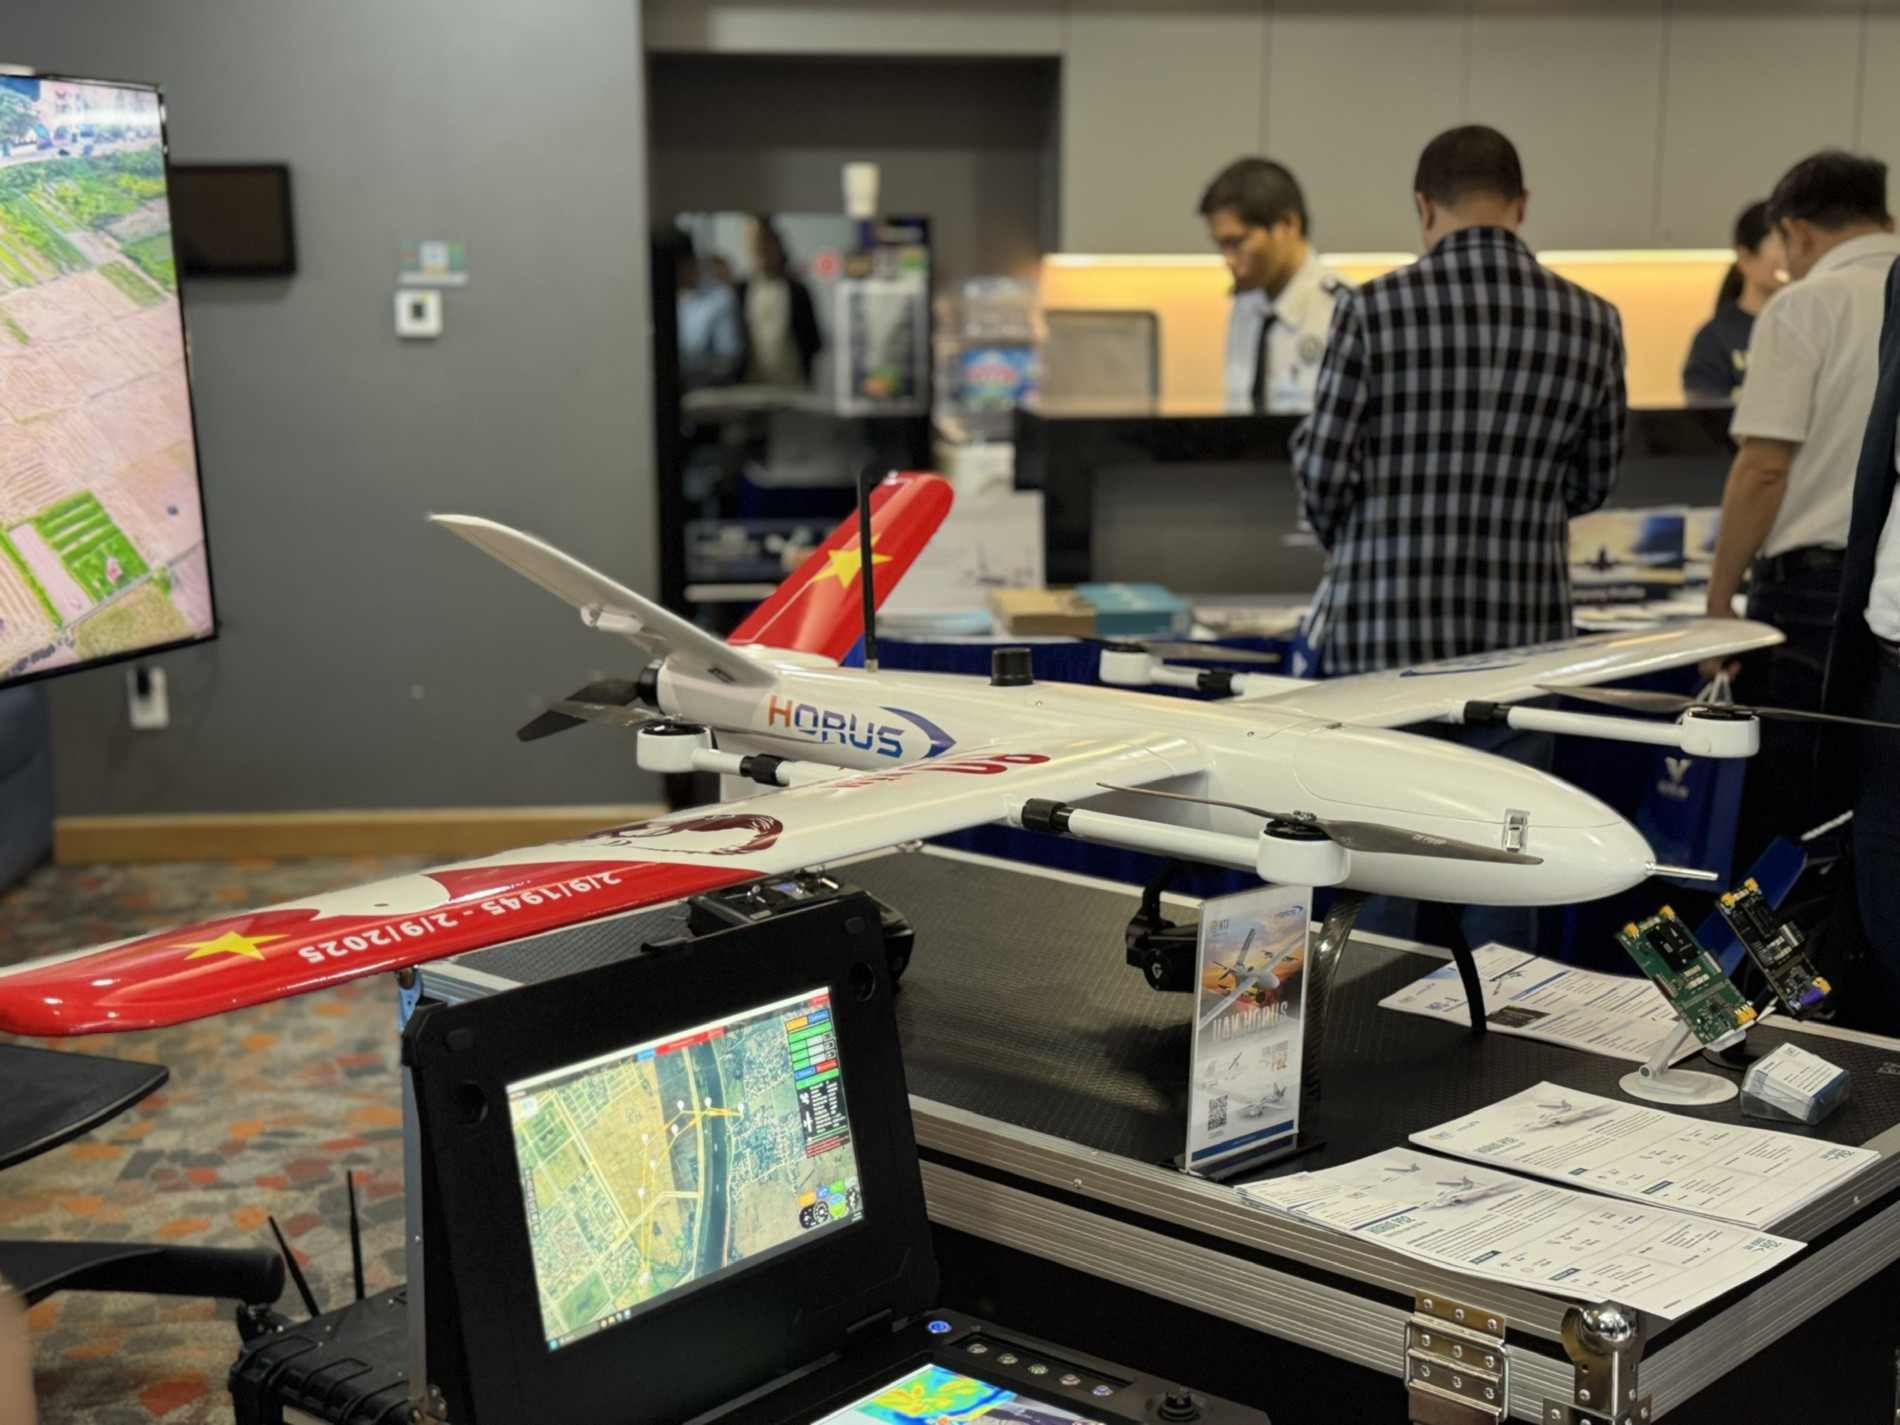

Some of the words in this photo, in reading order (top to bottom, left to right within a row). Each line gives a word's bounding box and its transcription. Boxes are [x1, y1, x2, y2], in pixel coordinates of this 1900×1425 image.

[768, 695, 905, 759] HORUS
[482, 872, 622, 915] 2/9/1945
[298, 913, 459, 964] 2/9/2025
[1212, 1013, 1242, 1042] UAV
[1244, 1001, 1288, 1034] HORUS
